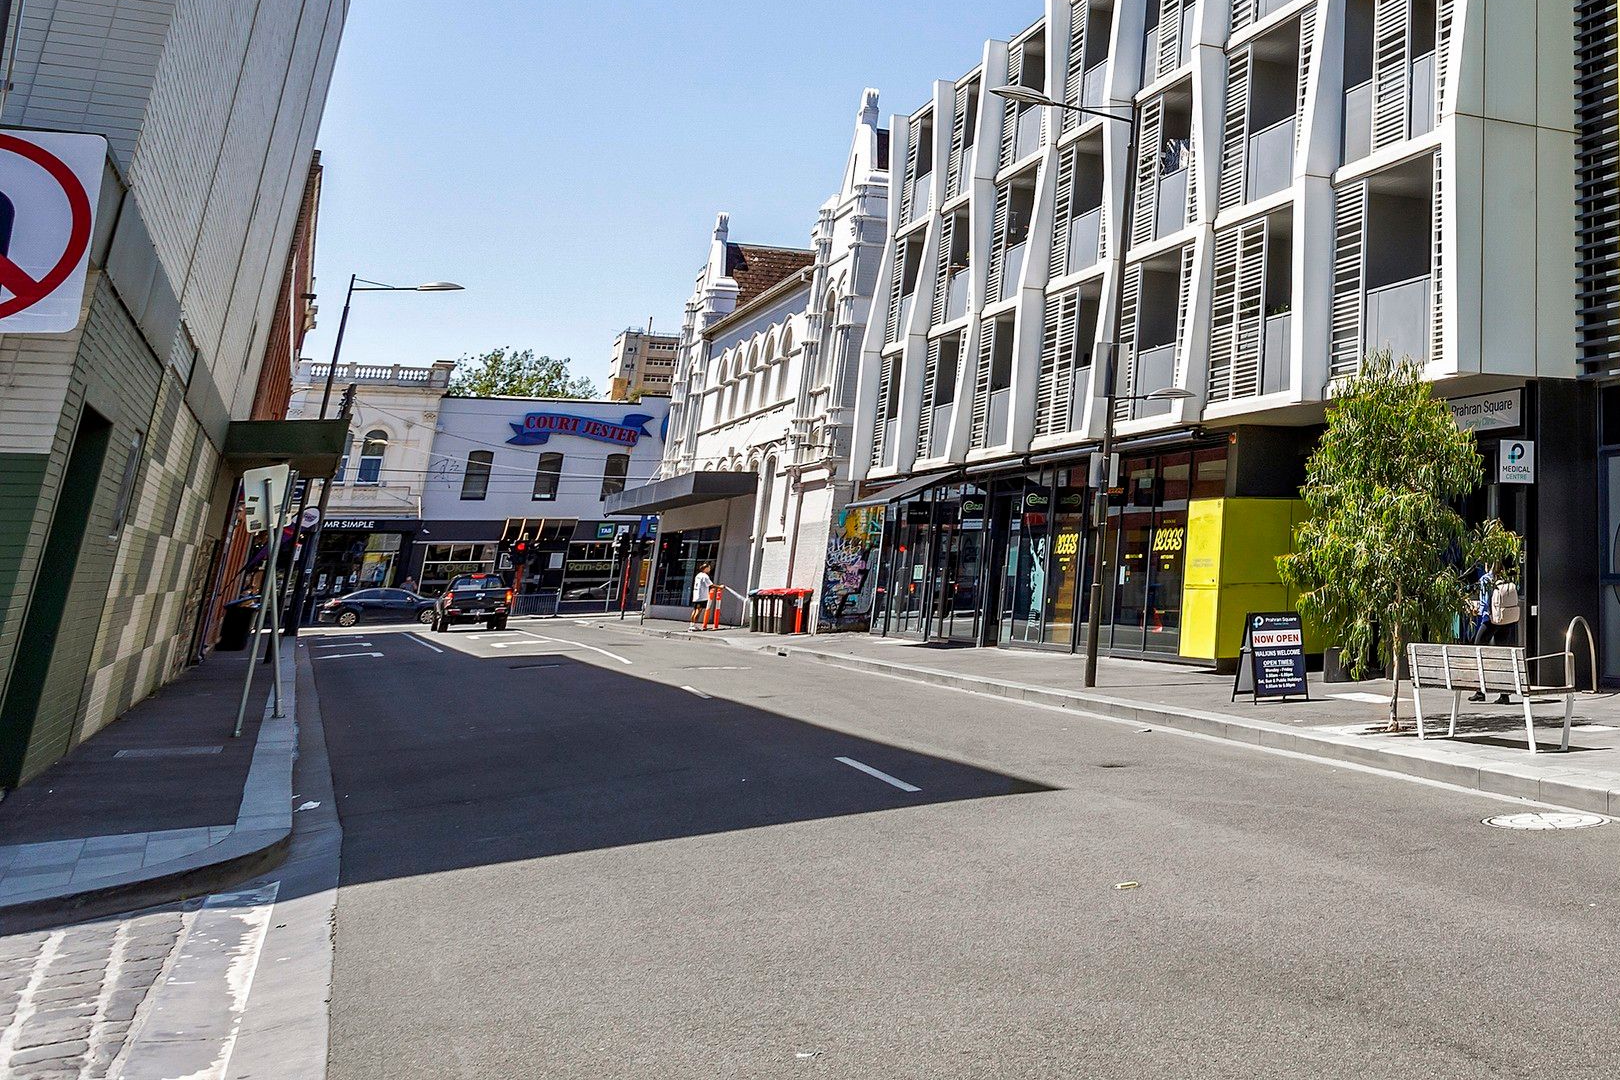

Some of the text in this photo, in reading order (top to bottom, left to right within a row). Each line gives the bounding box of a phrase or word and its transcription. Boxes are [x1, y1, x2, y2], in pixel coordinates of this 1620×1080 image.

[1451, 399, 1513, 417] Prahran Square
[525, 415, 638, 443] COURT JESTER
[1502, 465, 1531, 473] MEDICAL
[323, 520, 375, 529] MR SIMPLE
[436, 563, 479, 573] POKIES
[1254, 633, 1299, 644] NOW OPEN
